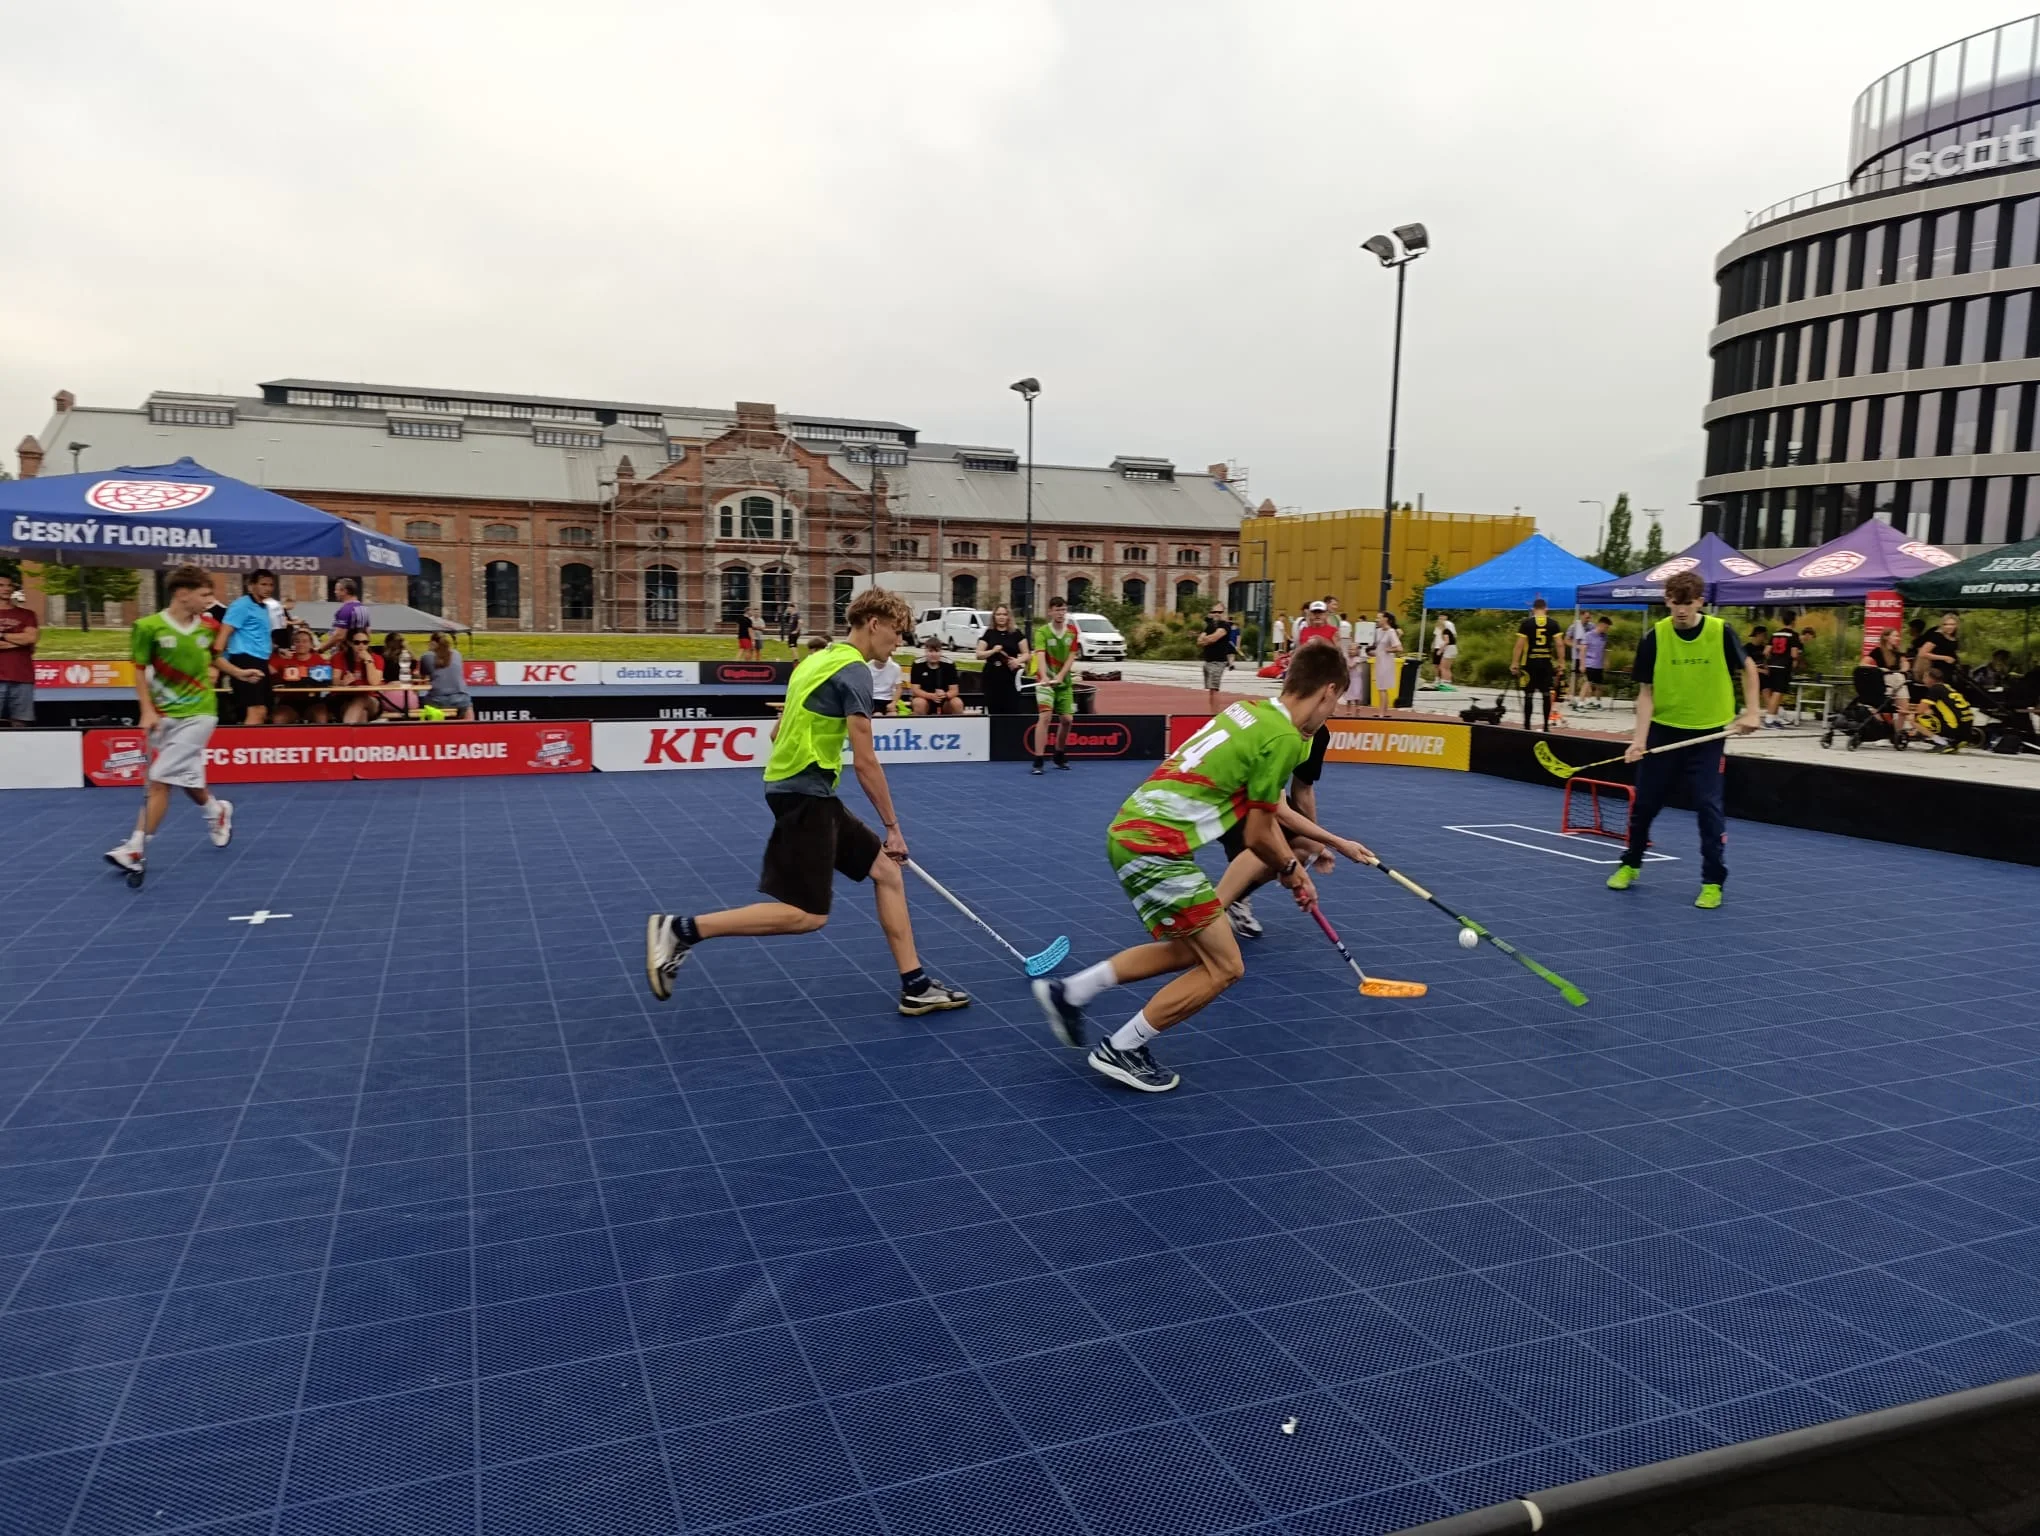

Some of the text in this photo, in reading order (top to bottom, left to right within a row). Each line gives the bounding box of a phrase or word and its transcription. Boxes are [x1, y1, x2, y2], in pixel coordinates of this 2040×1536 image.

[12, 516, 217, 548] ČESKÝ FLORBAL
[1535, 628, 1547, 645] 5
[522, 665, 577, 682] KFC
[643, 727, 757, 764] KFC
[842, 728, 961, 752] ník.cz
[1386, 734, 1445, 755] POWER
[203, 743, 508, 765] FC STREET FLOORBALL LEAGUE
